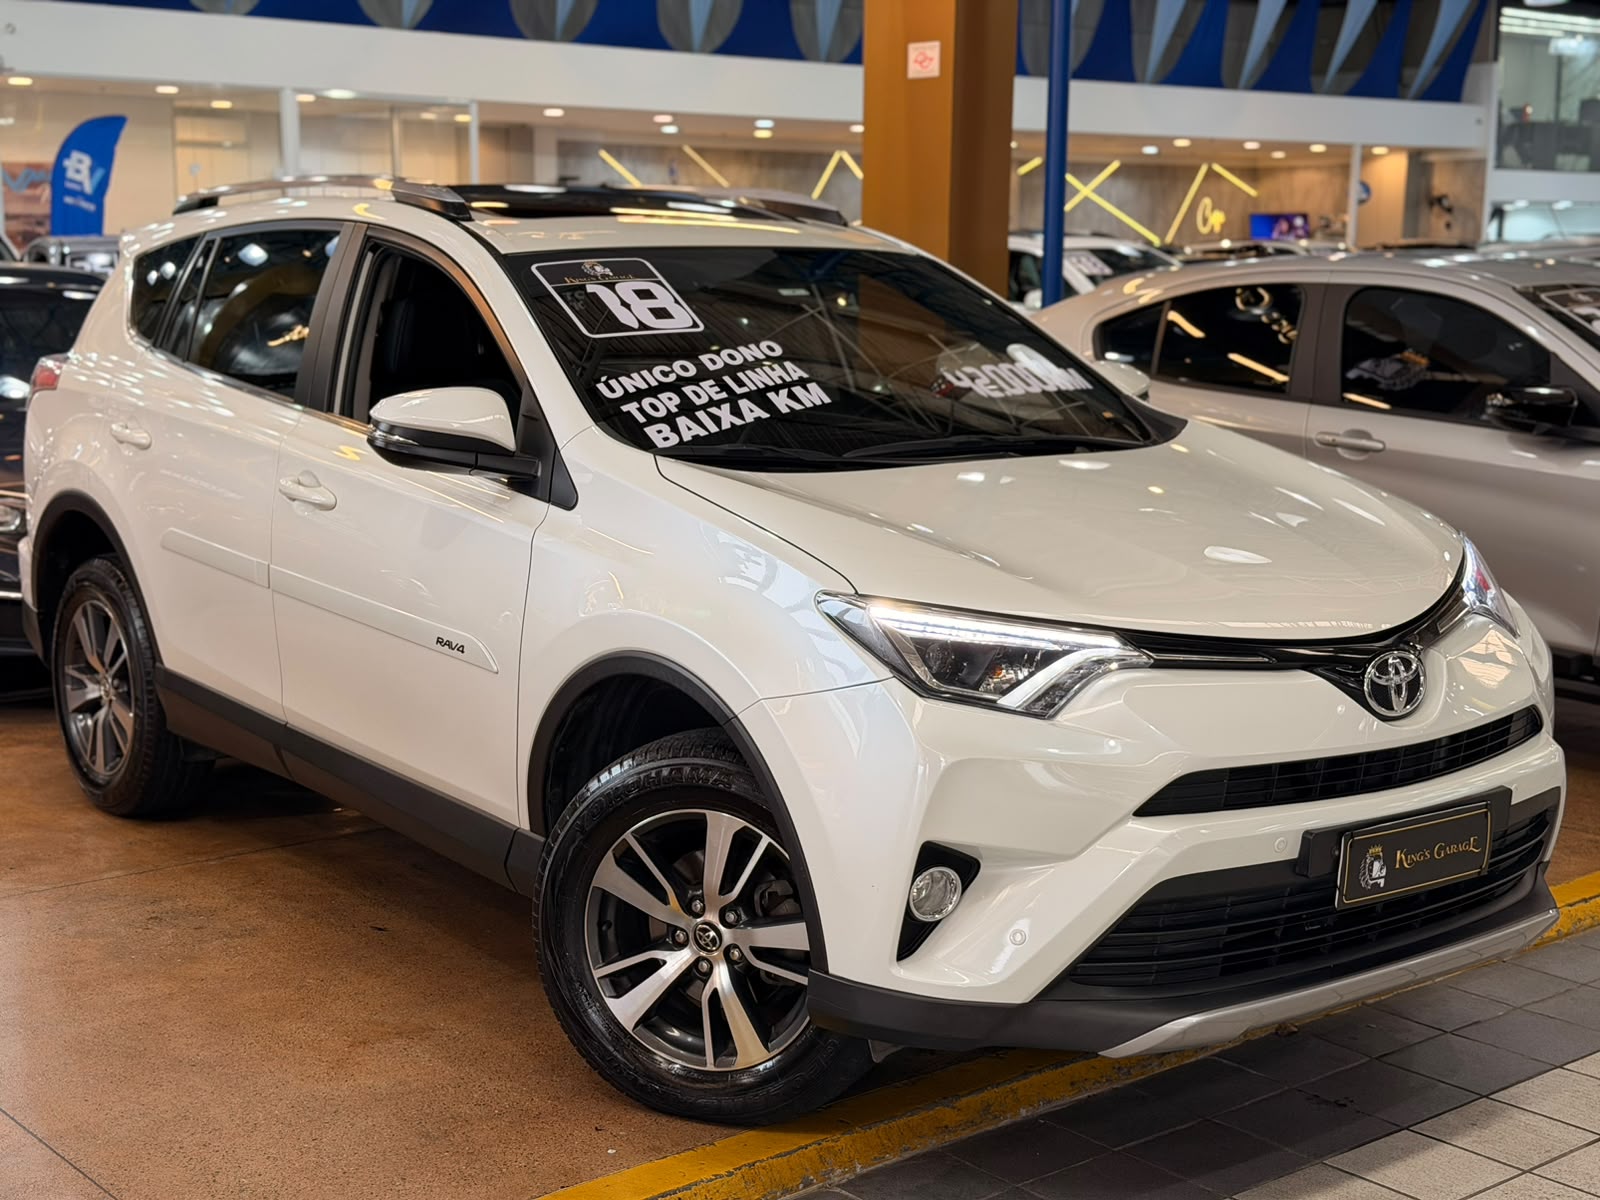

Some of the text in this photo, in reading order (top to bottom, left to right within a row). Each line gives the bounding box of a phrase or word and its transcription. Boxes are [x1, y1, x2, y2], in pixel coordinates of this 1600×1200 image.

[586, 281, 693, 329] 18
[596, 340, 783, 399] ÚNICO DONO
[620, 360, 810, 424] TOP DE LINHA
[644, 382, 832, 449] BAIXA KM
[435, 636, 465, 654] RAV4
[1394, 836, 1482, 869] KING'S GARAGE
